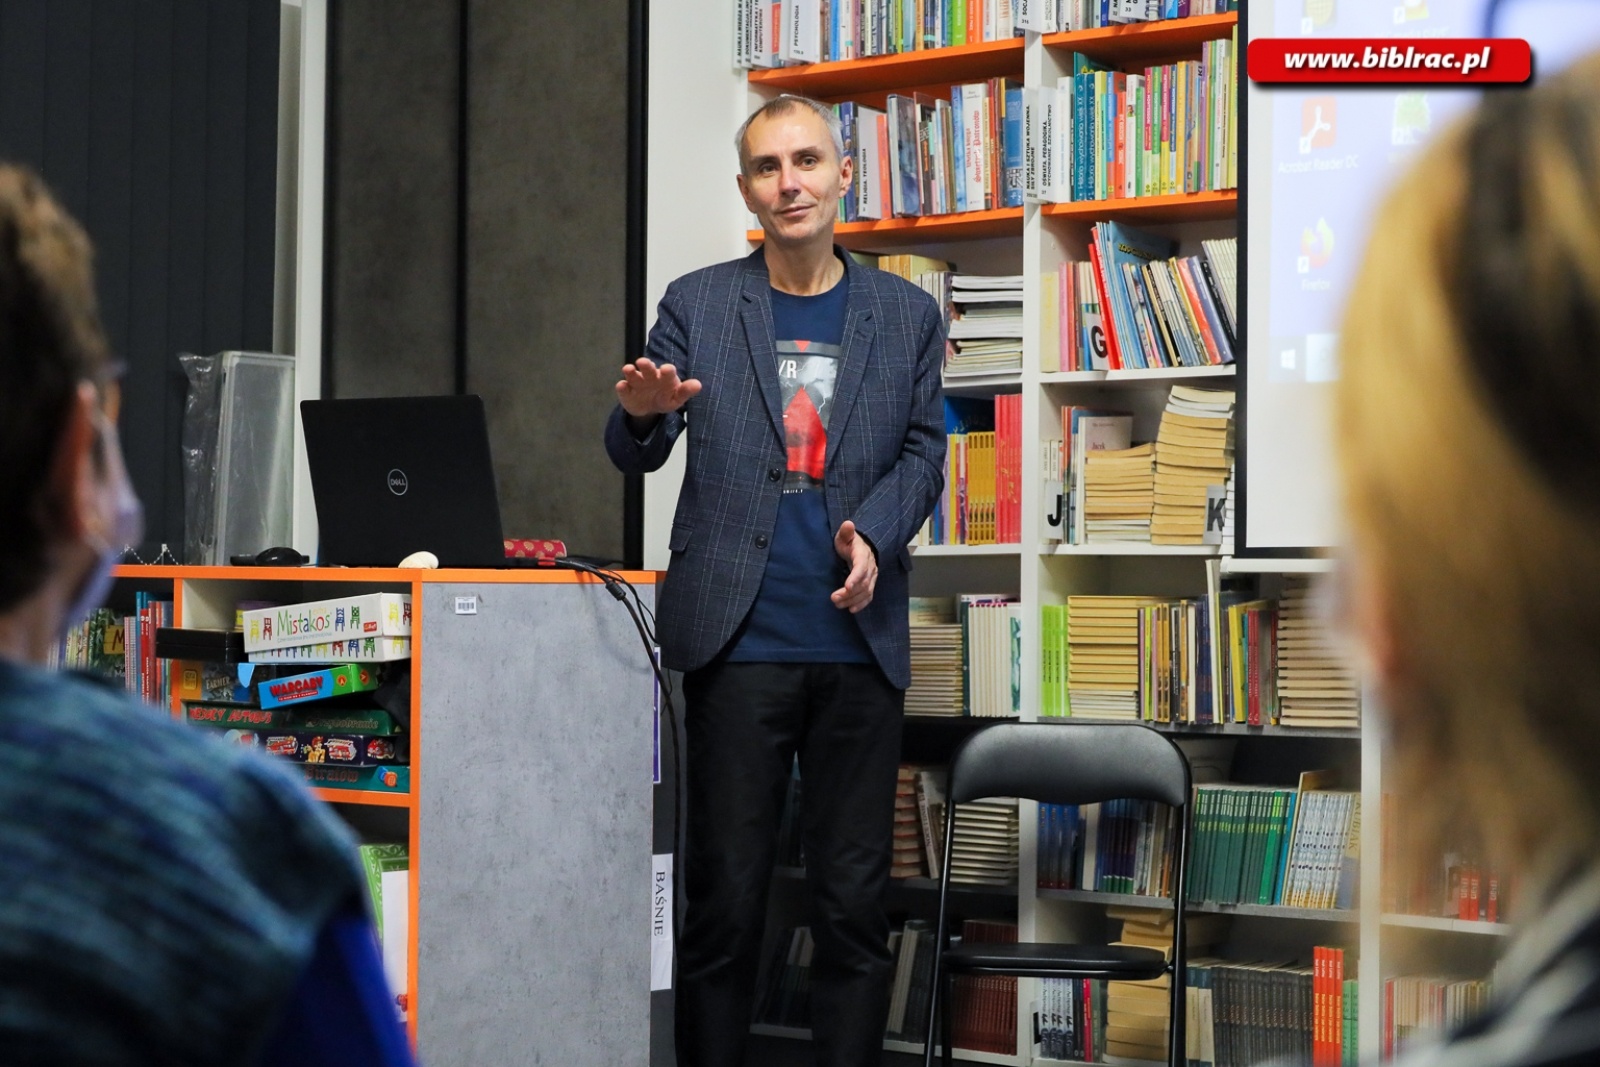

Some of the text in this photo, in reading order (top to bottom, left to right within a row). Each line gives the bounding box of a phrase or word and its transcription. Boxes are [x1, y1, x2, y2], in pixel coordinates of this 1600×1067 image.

[1314, 158, 1344, 170] Reader
[1091, 326, 1108, 358] G
[390, 478, 406, 486] DELL
[1048, 494, 1062, 526] J
[1207, 498, 1227, 532] K
[277, 609, 330, 636] Mistakos
[270, 676, 324, 696] WARCABY
[227, 710, 272, 724] AUTOBUS
[653, 870, 666, 936] BAŚNIE
